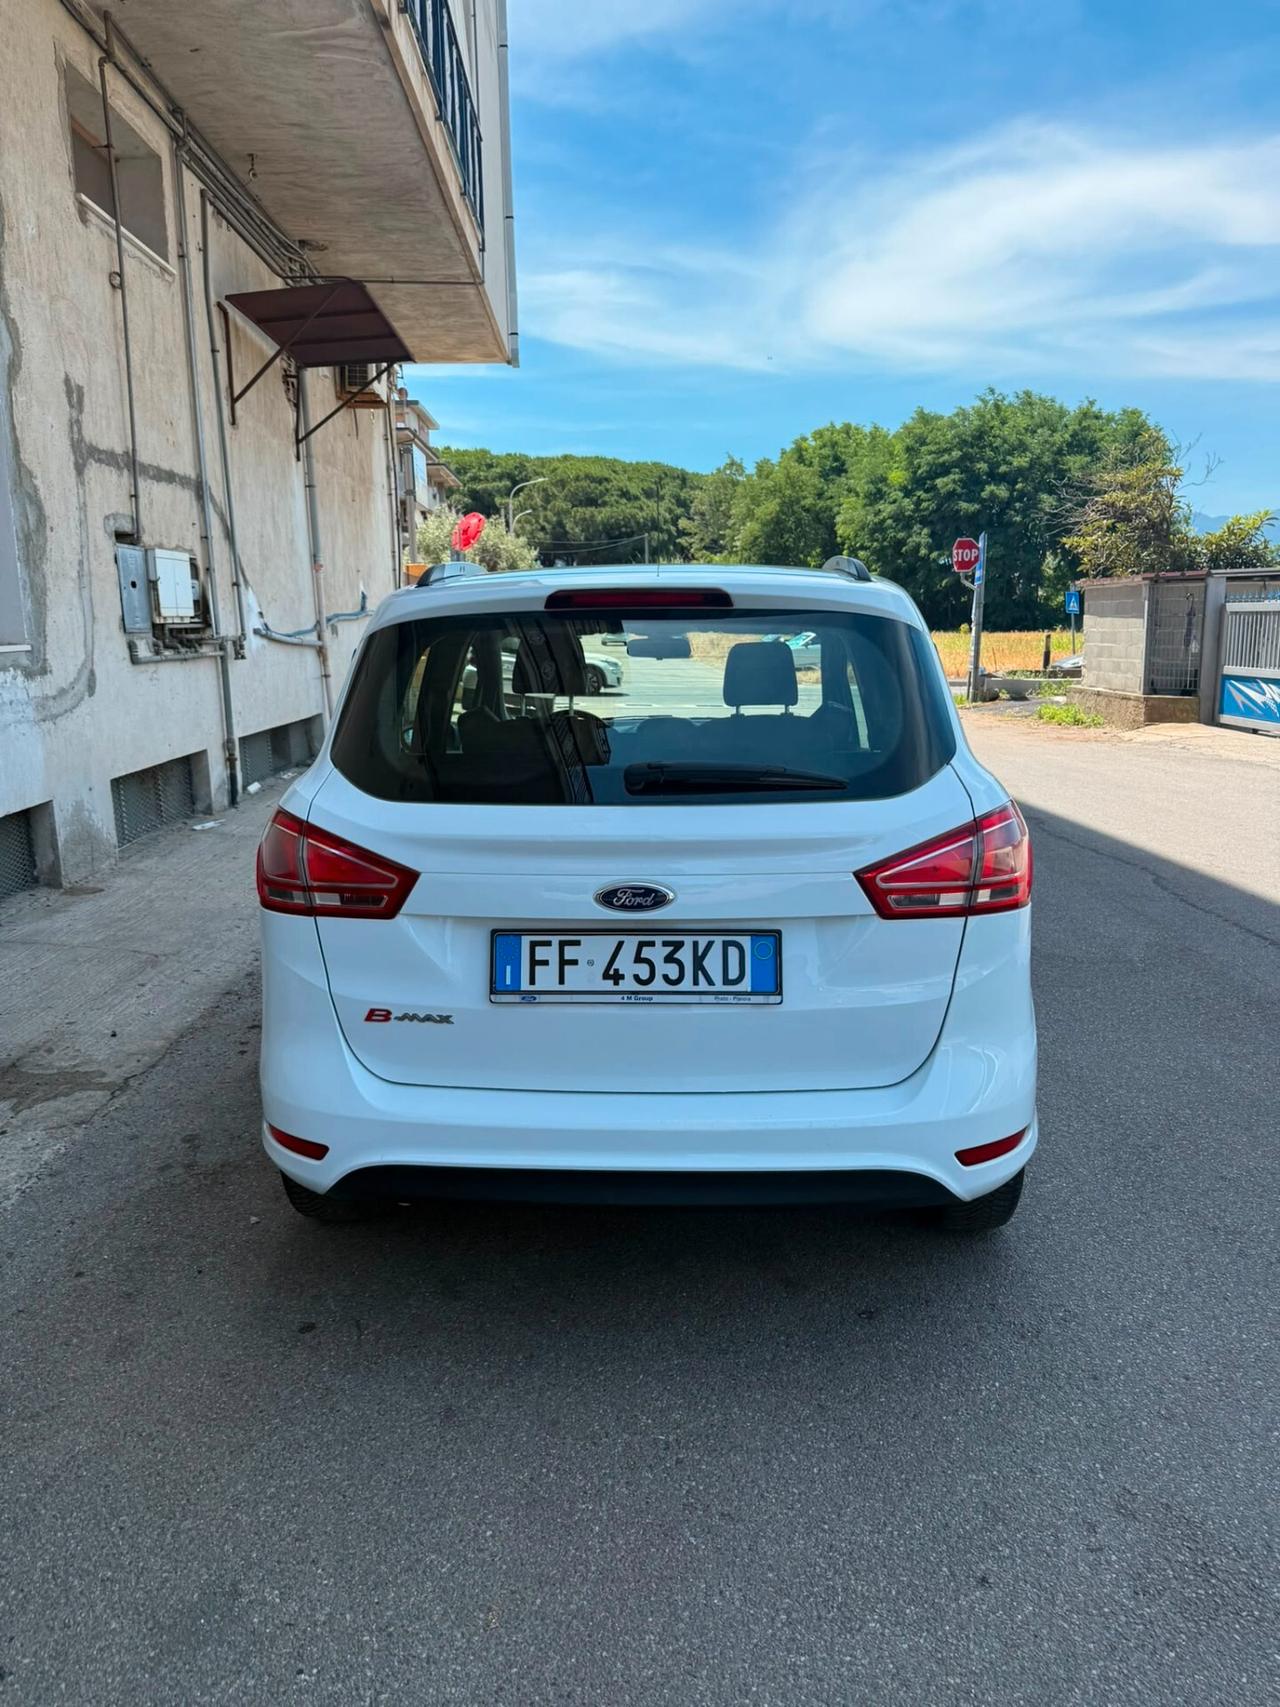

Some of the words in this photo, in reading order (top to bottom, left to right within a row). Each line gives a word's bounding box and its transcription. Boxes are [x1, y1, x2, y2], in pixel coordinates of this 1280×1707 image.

[953, 548, 979, 562] STOP
[613, 888, 655, 906] Ford
[505, 965, 511, 985] I
